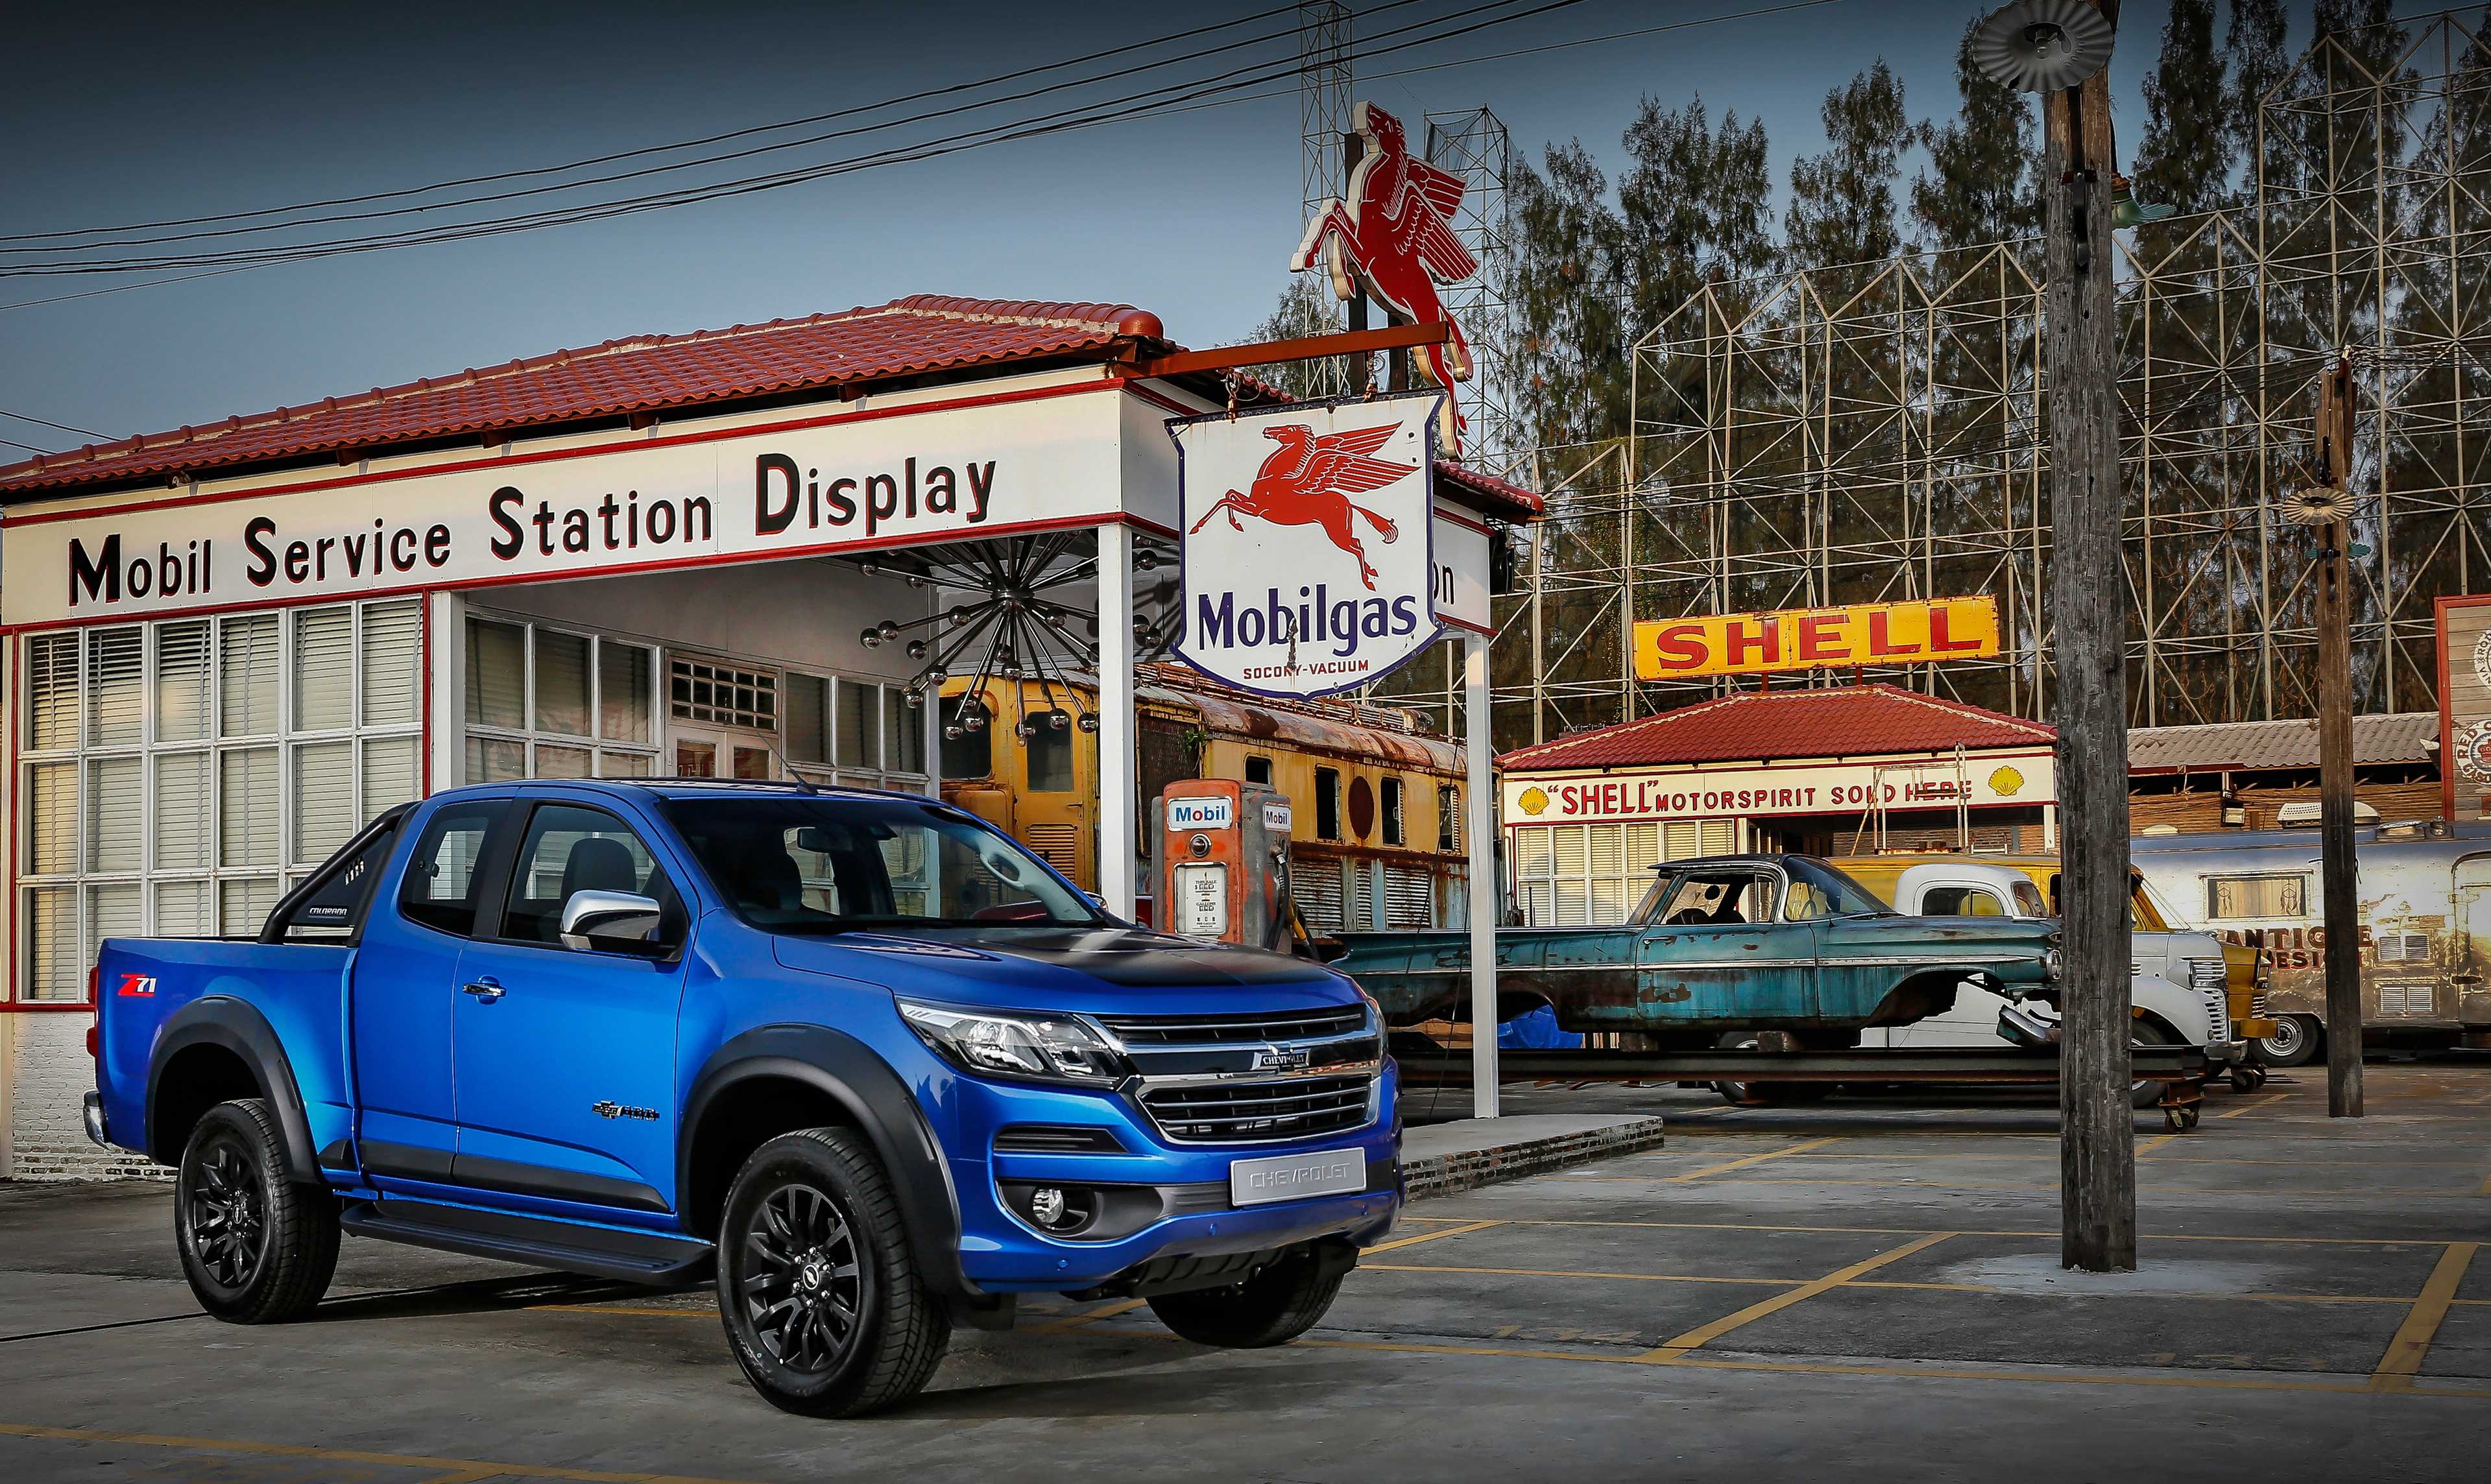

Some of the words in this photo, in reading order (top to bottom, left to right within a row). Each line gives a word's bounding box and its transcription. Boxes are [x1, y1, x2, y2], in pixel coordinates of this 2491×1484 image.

[69, 533, 212, 607] Mobil
[245, 516, 451, 588] Service
[489, 485, 713, 561] Station
[754, 453, 996, 536] Display
[1198, 583, 1417, 657] Mobilgas
[1657, 608, 1983, 669] SHELL
[1244, 659, 1369, 680] SOCONY-VACUUM
[1831, 784, 1896, 804] SOLD
[1175, 805, 1225, 822] Mobil
[1266, 811, 1288, 825] Mobil
[2226, 926, 2373, 951] ANTIQE
[118, 973, 157, 997] Z71
[1262, 1054, 1305, 1065] CHEVROLET
[1250, 1162, 1351, 1189] CHEVROLET
